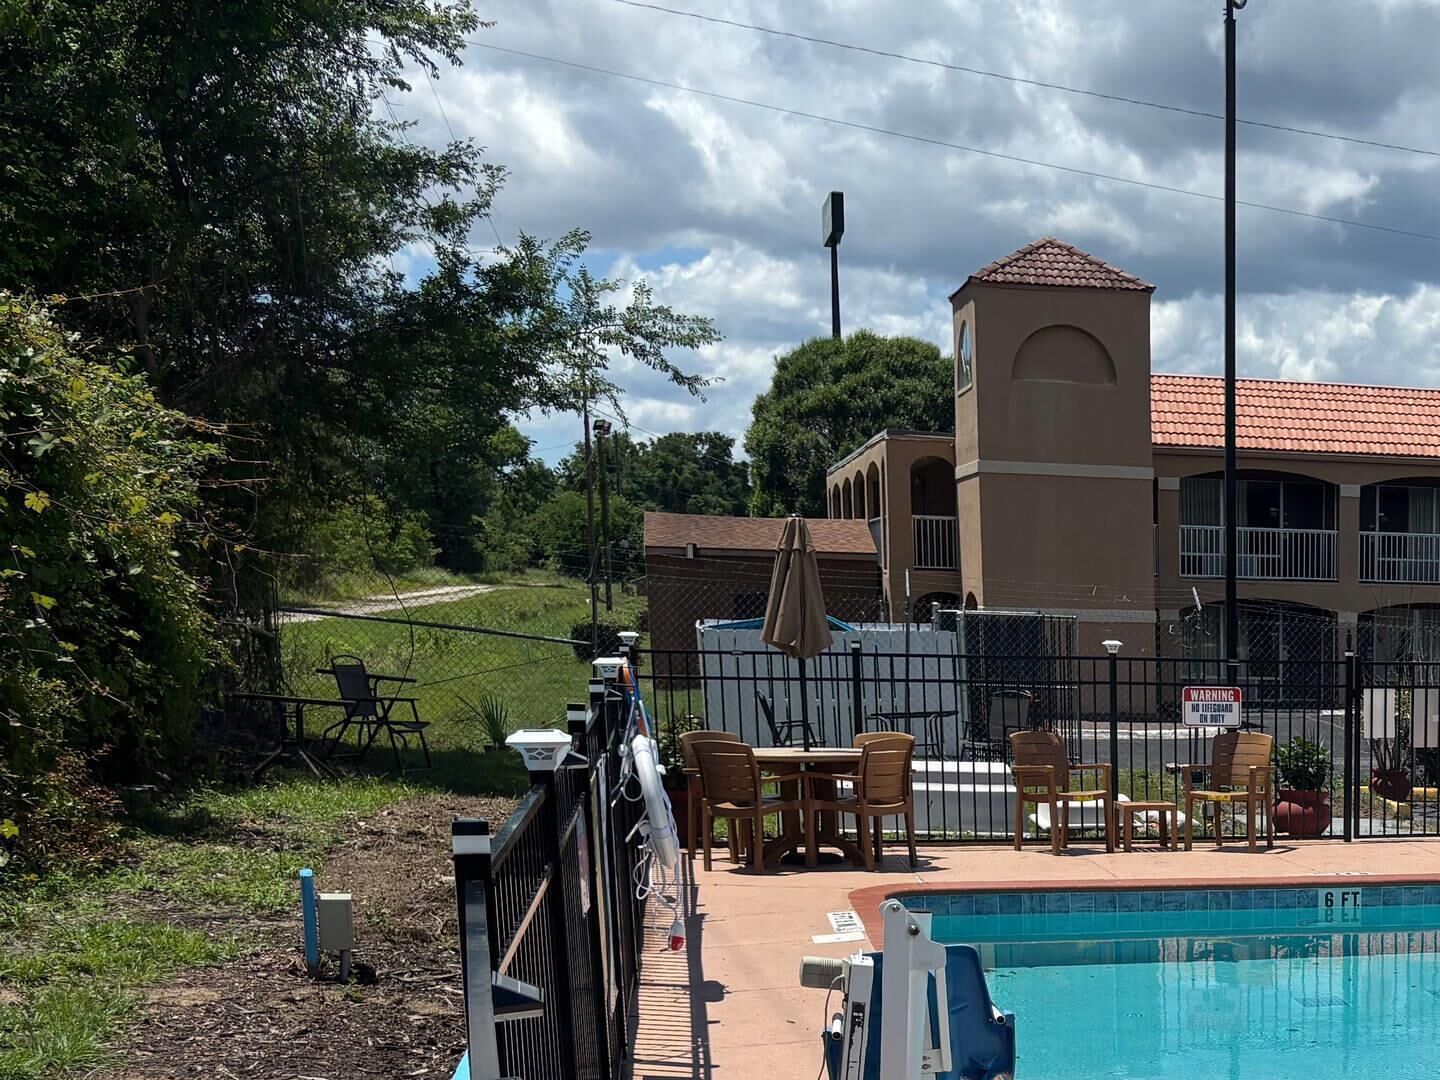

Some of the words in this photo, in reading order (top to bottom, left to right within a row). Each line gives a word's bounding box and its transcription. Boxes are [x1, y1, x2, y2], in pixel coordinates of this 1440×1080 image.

[1190, 689, 1234, 701] WARNING
[1191, 703, 1200, 713] NO
[1202, 703, 1233, 713] LIFEGUARD
[1200, 714, 1208, 723] ON
[1210, 714, 1225, 723] DUTY
[1324, 891, 1334, 908] 6
